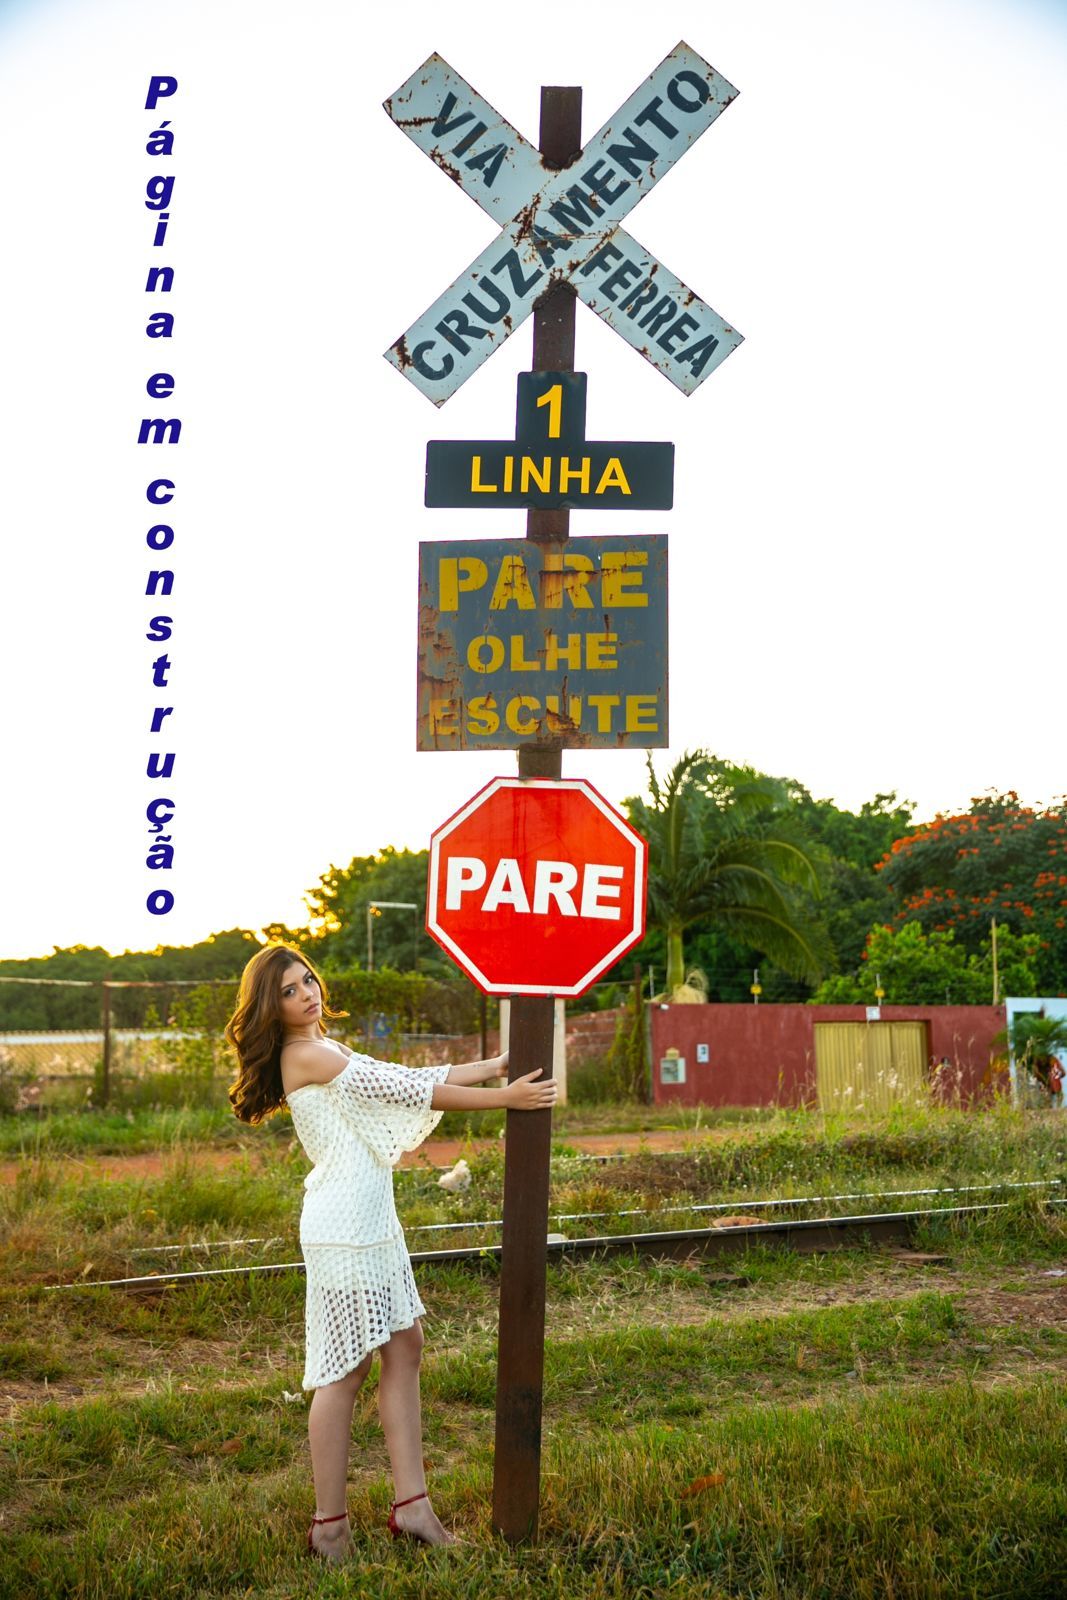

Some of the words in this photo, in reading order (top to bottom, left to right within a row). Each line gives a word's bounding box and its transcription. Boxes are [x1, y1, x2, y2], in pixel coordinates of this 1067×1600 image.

[430, 91, 509, 188] VIA
[411, 70, 710, 381] CRUZAMENTO
[536, 384, 562, 438] 1
[470, 455, 632, 495] LINHA
[438, 551, 649, 612] PARE
[466, 632, 618, 674] OLHE
[428, 694, 659, 736] ESCUTE
[445, 856, 624, 921] PARE
